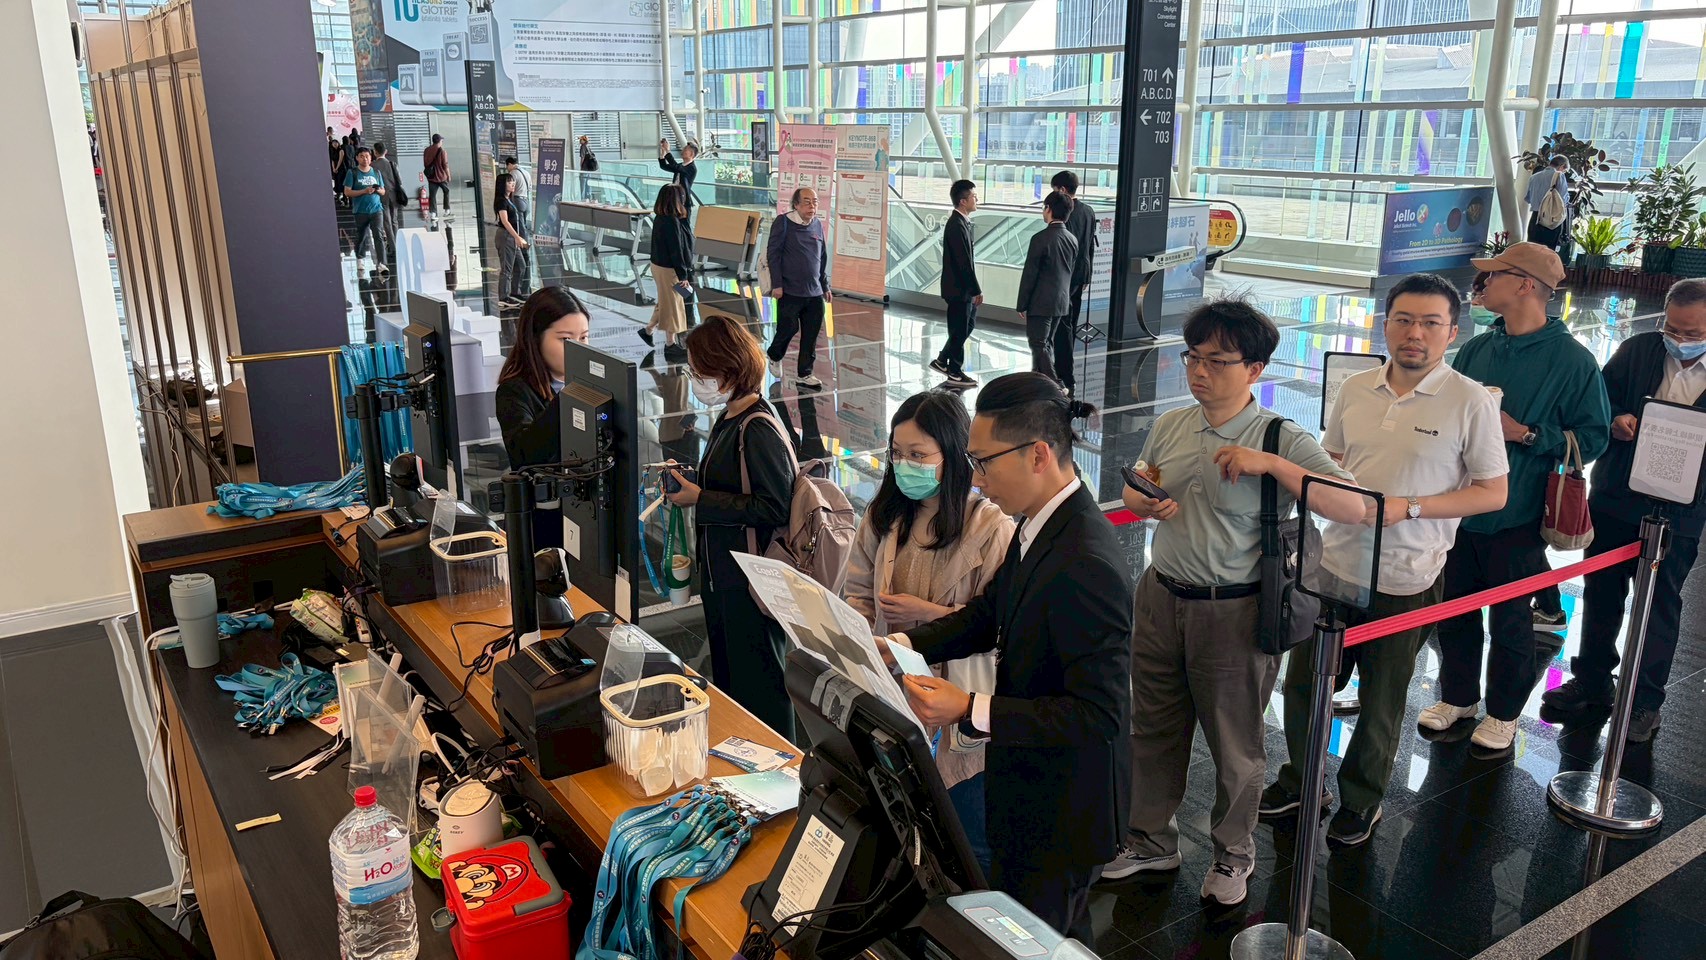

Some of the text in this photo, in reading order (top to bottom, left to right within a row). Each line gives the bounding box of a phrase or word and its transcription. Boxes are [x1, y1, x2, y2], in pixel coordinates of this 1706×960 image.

[421, 5, 458, 16] GIOTRIF
[1143, 69, 1158, 82] 701
[1141, 88, 1173, 100] A.B.C.D.
[1156, 111, 1171, 124] 702
[1154, 131, 1170, 144] 703
[544, 159, 558, 171] 學分
[1167, 215, 1196, 229] 絆腳石
